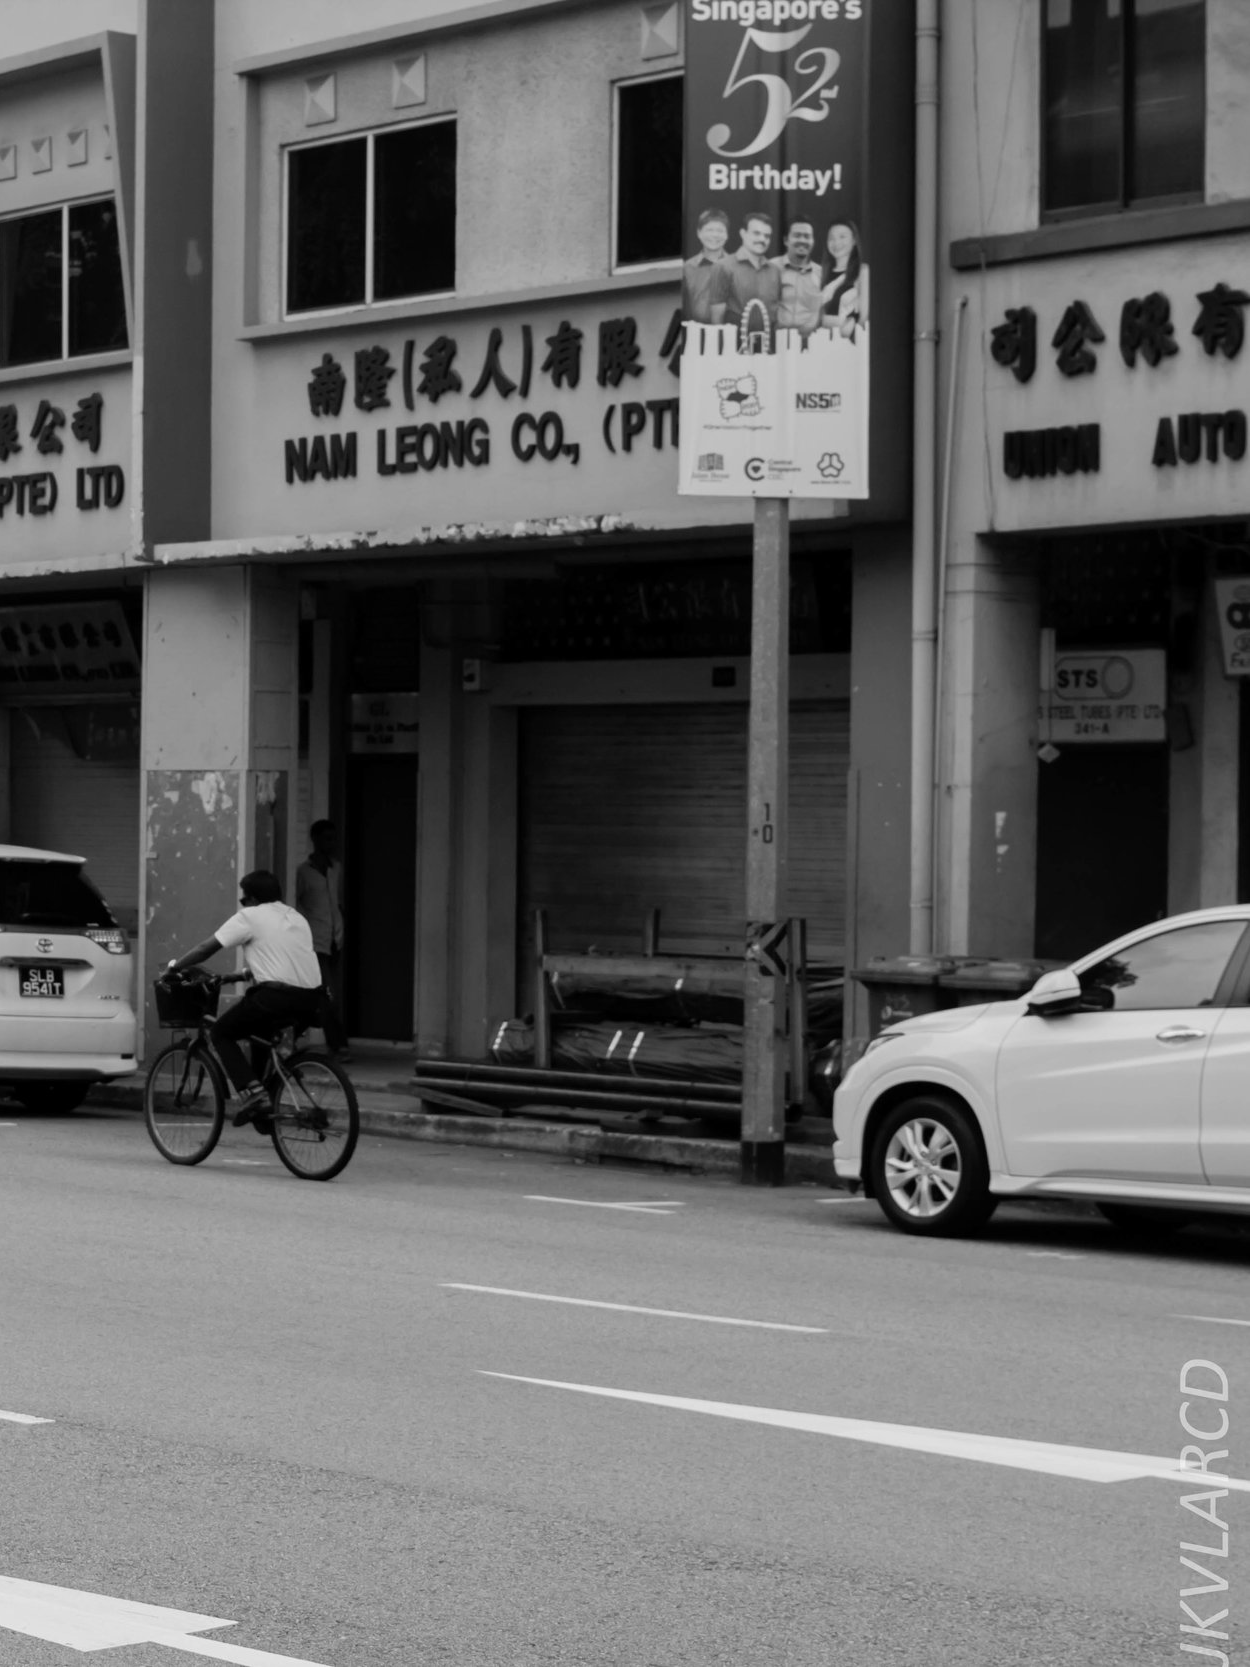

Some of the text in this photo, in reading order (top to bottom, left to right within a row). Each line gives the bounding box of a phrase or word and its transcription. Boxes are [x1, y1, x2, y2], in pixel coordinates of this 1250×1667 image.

[692, 0, 863, 26] Singapores
[708, 163, 842, 196] Birthday!
[284, 431, 358, 485] NAM
[376, 416, 490, 476] LEONG
[1152, 409, 1248, 468] AUTO
[75, 464, 125, 511] LTD
[1057, 669, 1098, 688] STS
[23, 982, 62, 996] 9541T
[29, 969, 54, 983] SLB
